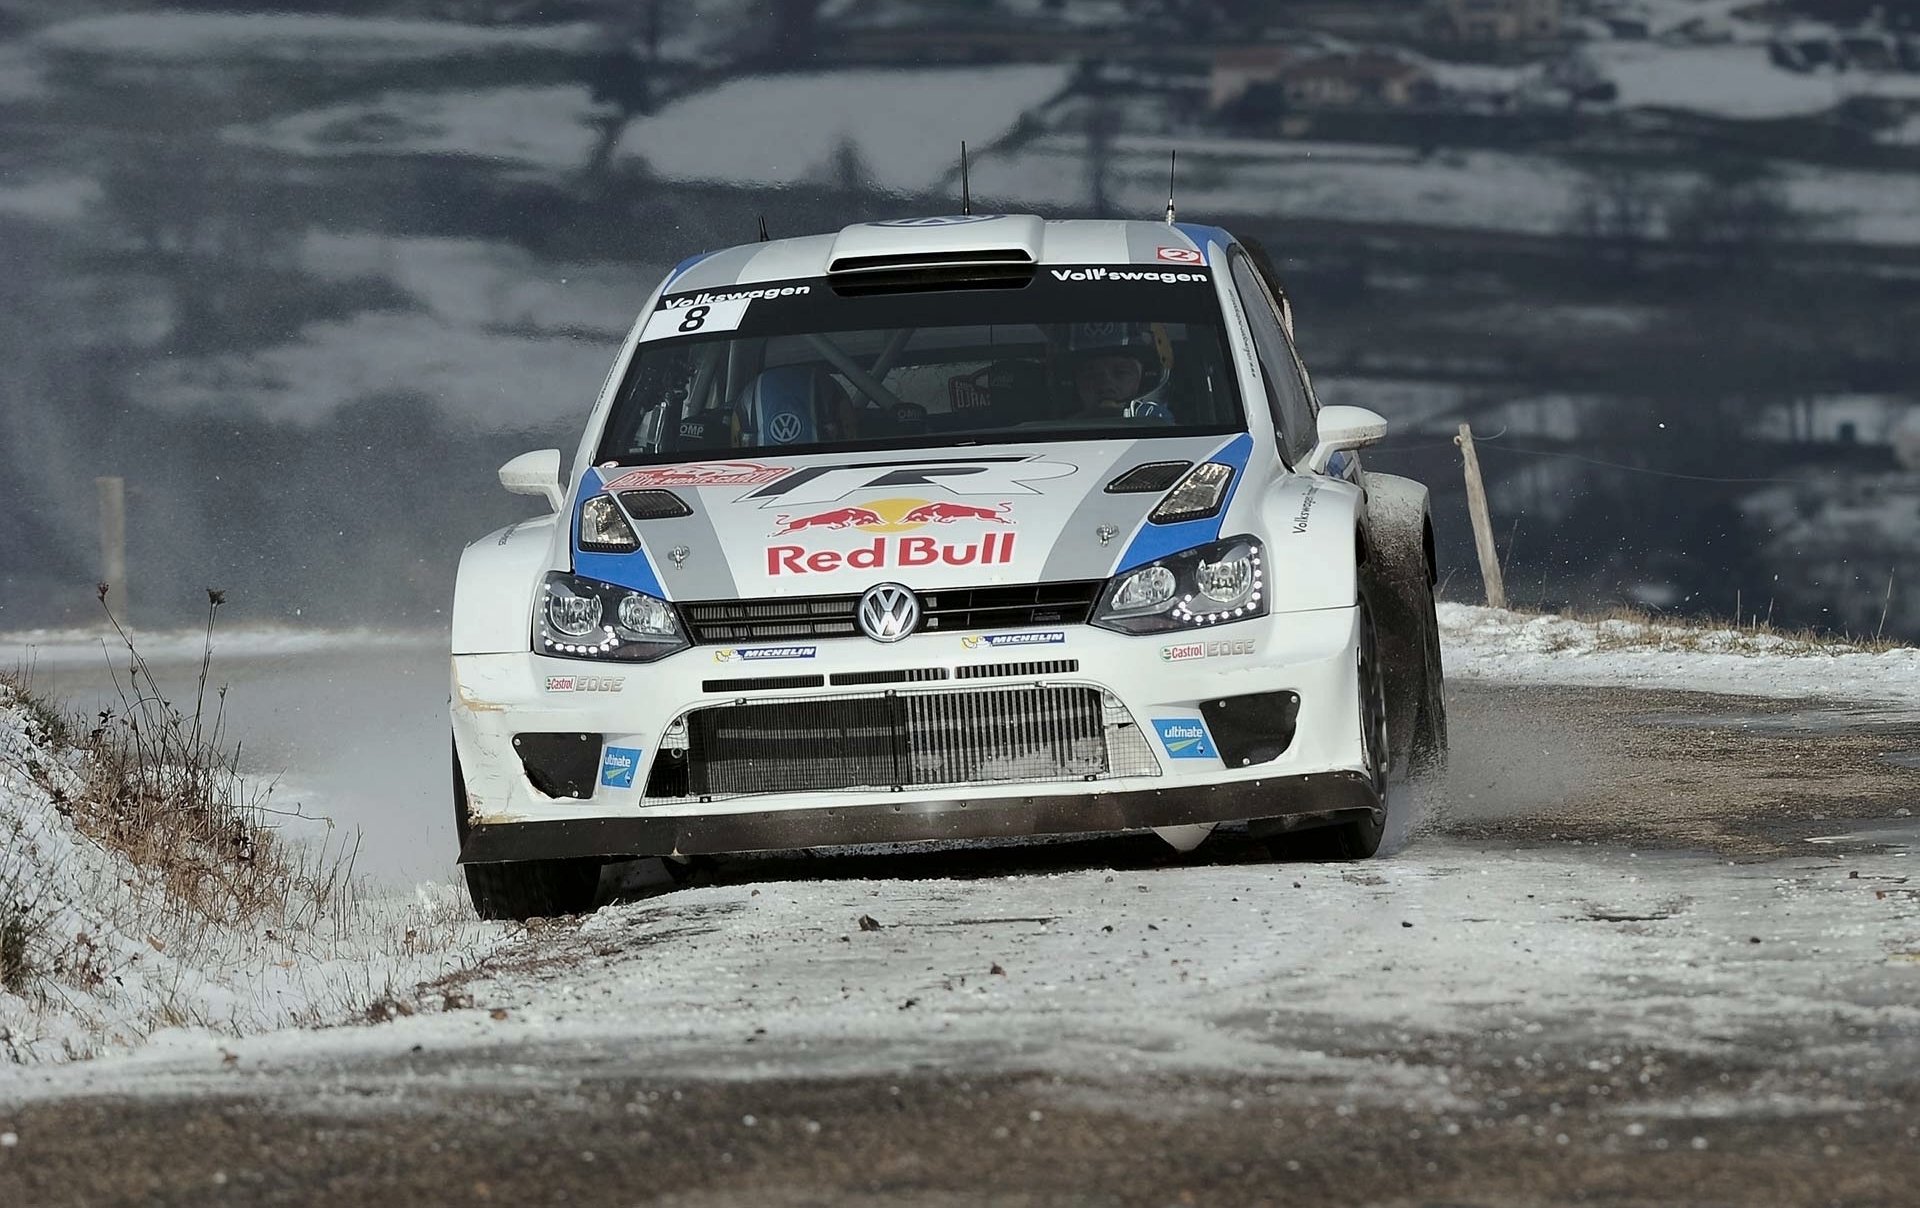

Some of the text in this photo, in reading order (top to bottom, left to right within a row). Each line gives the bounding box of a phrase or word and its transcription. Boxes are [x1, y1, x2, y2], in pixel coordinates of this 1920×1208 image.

[678, 305, 711, 333] 8
[679, 424, 705, 436] OMP
[767, 533, 1015, 576] Red Bull
[991, 632, 1064, 644] MICHELIN
[744, 647, 816, 659] MICHELIN
[1171, 639, 1256, 659] Castrol EDGE
[550, 676, 626, 692] Castrol EDGE
[1164, 725, 1203, 739] ultimate
